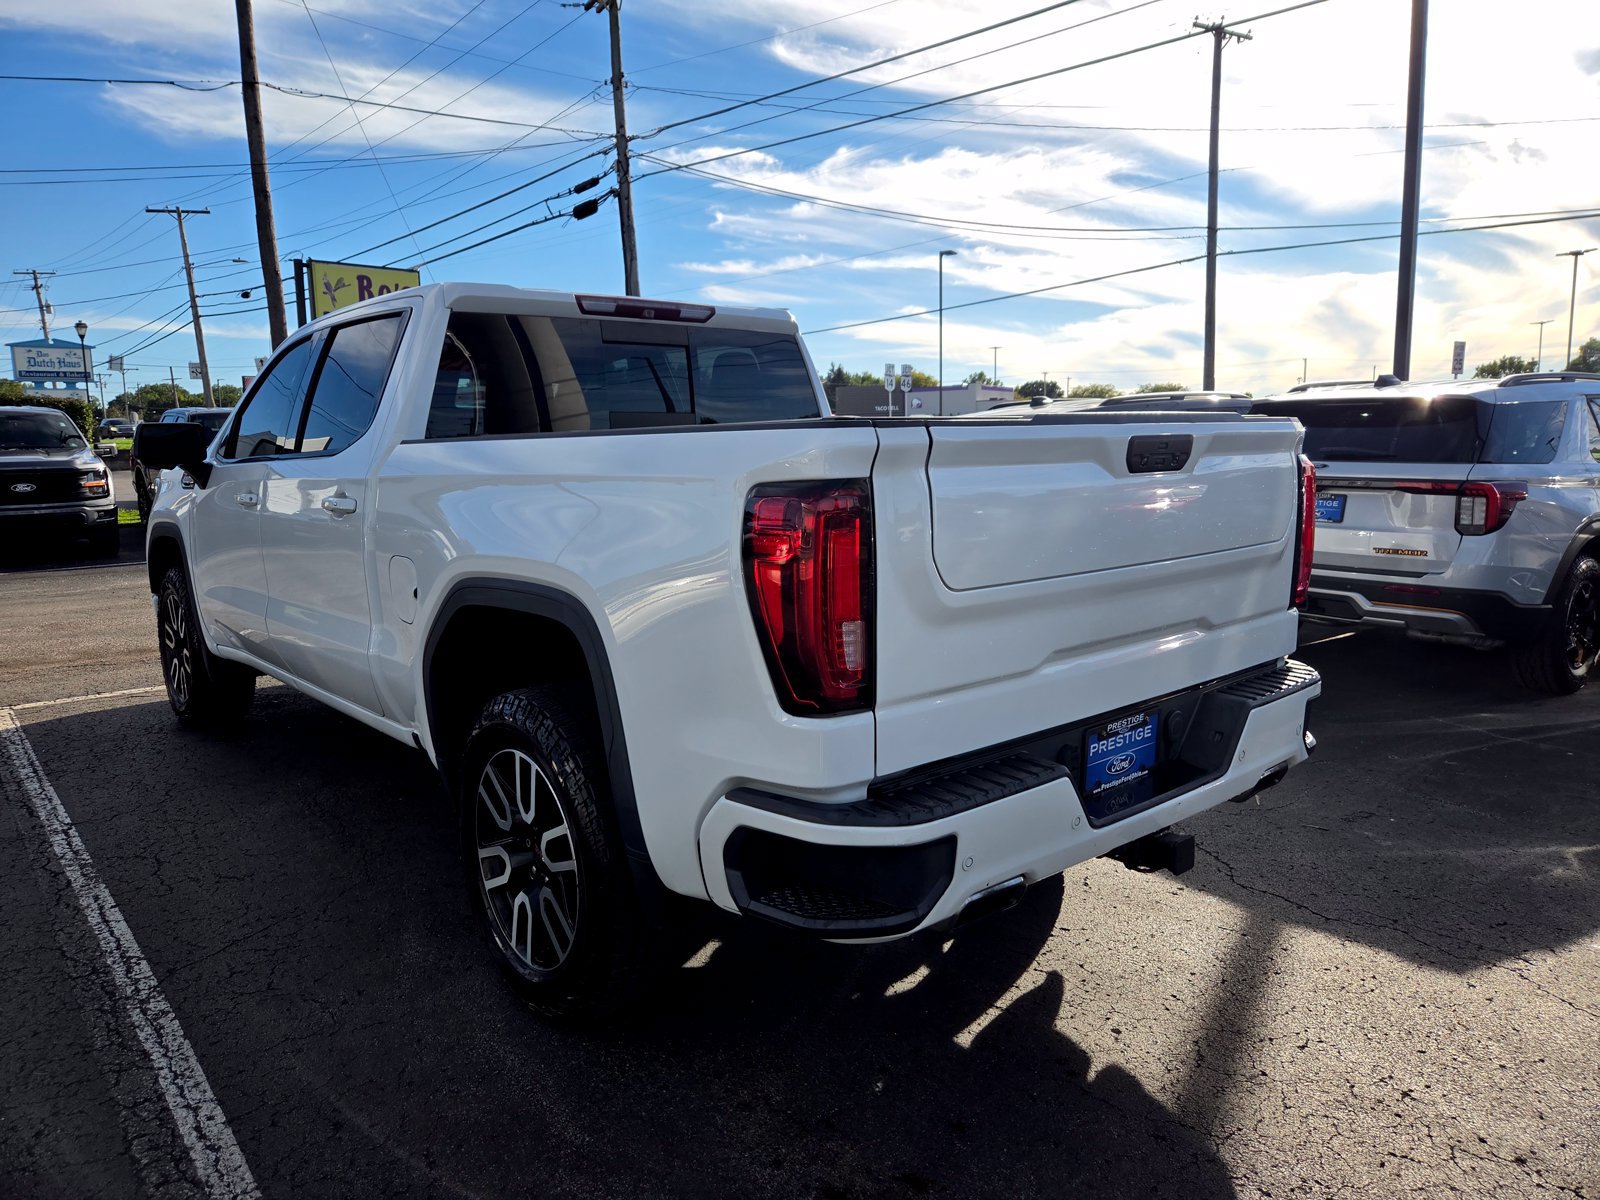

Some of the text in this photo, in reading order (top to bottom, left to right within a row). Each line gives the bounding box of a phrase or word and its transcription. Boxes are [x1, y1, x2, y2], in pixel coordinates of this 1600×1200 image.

[26, 357, 82, 369] Dutch Haus
[1454, 358, 1463, 370] 25
[886, 378, 894, 388] 14
[901, 378, 911, 389] 46
[1372, 547, 1428, 557] TREMOR
[1107, 713, 1145, 732] PRESTIGE
[1089, 725, 1153, 757] PRESTIGE
[1110, 755, 1132, 773] Ford
